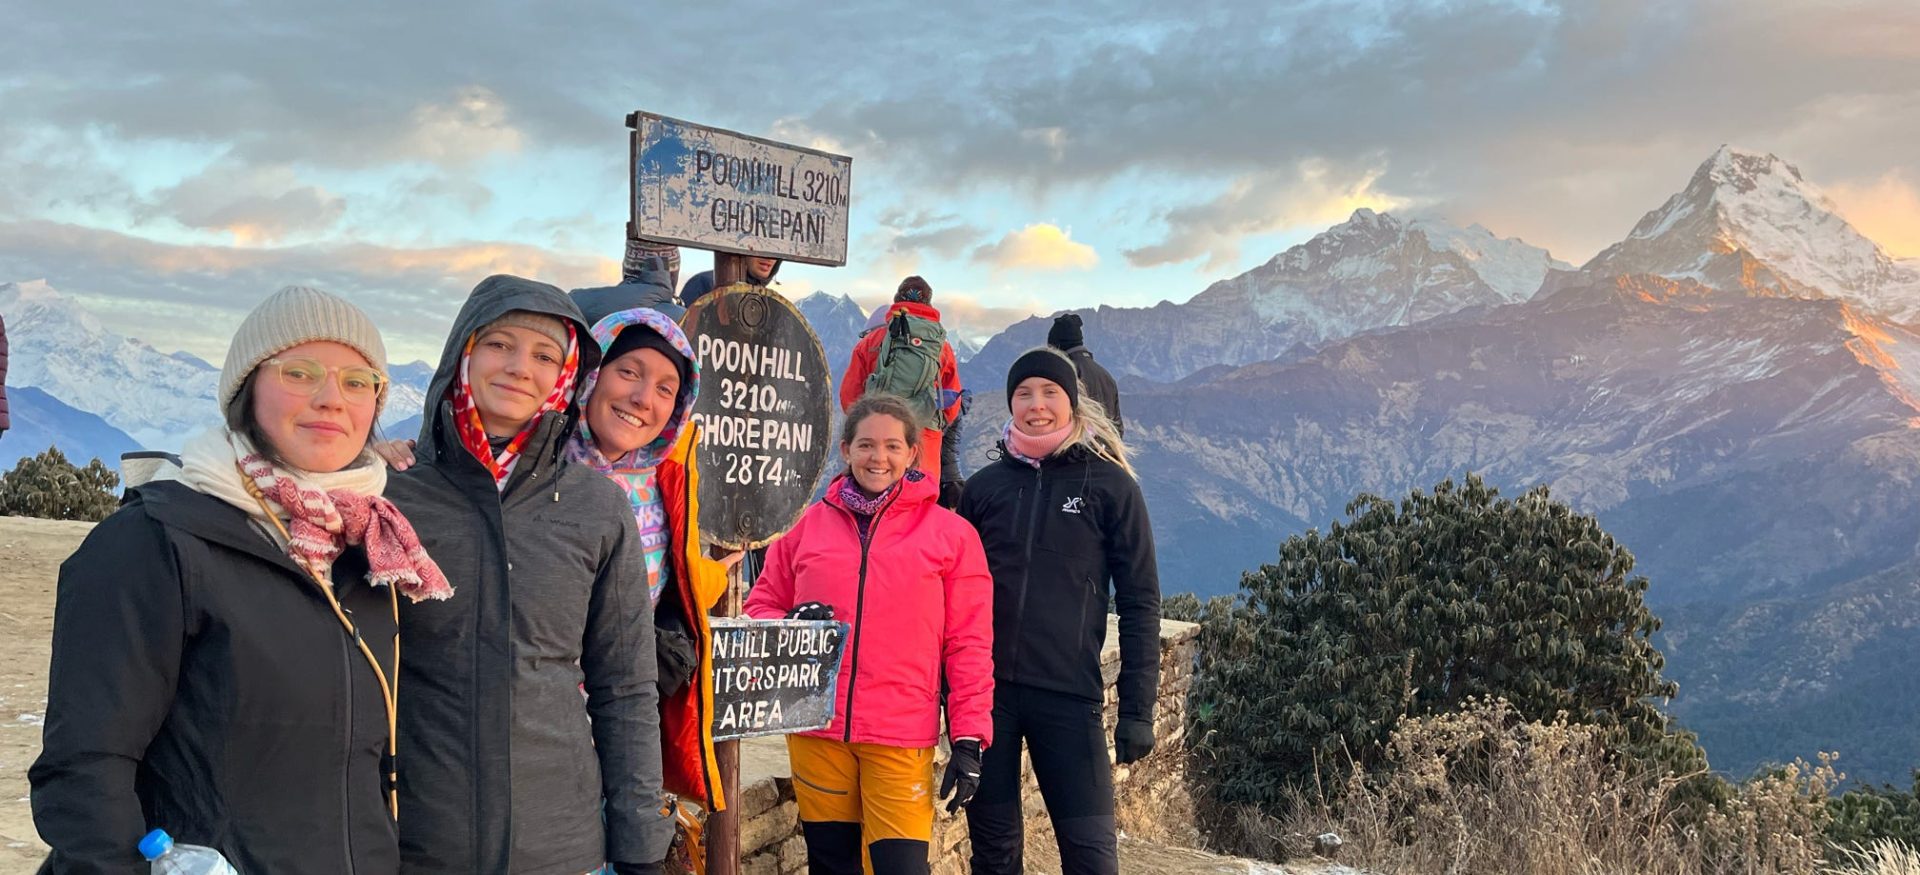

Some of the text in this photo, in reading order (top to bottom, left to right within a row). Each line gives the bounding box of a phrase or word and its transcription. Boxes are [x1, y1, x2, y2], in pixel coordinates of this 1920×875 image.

[711, 197, 826, 245] GHOREPANI
[777, 628, 838, 658] PUBLIC
[711, 663, 823, 694] ITORS PARK
[718, 699, 784, 730] AREA
